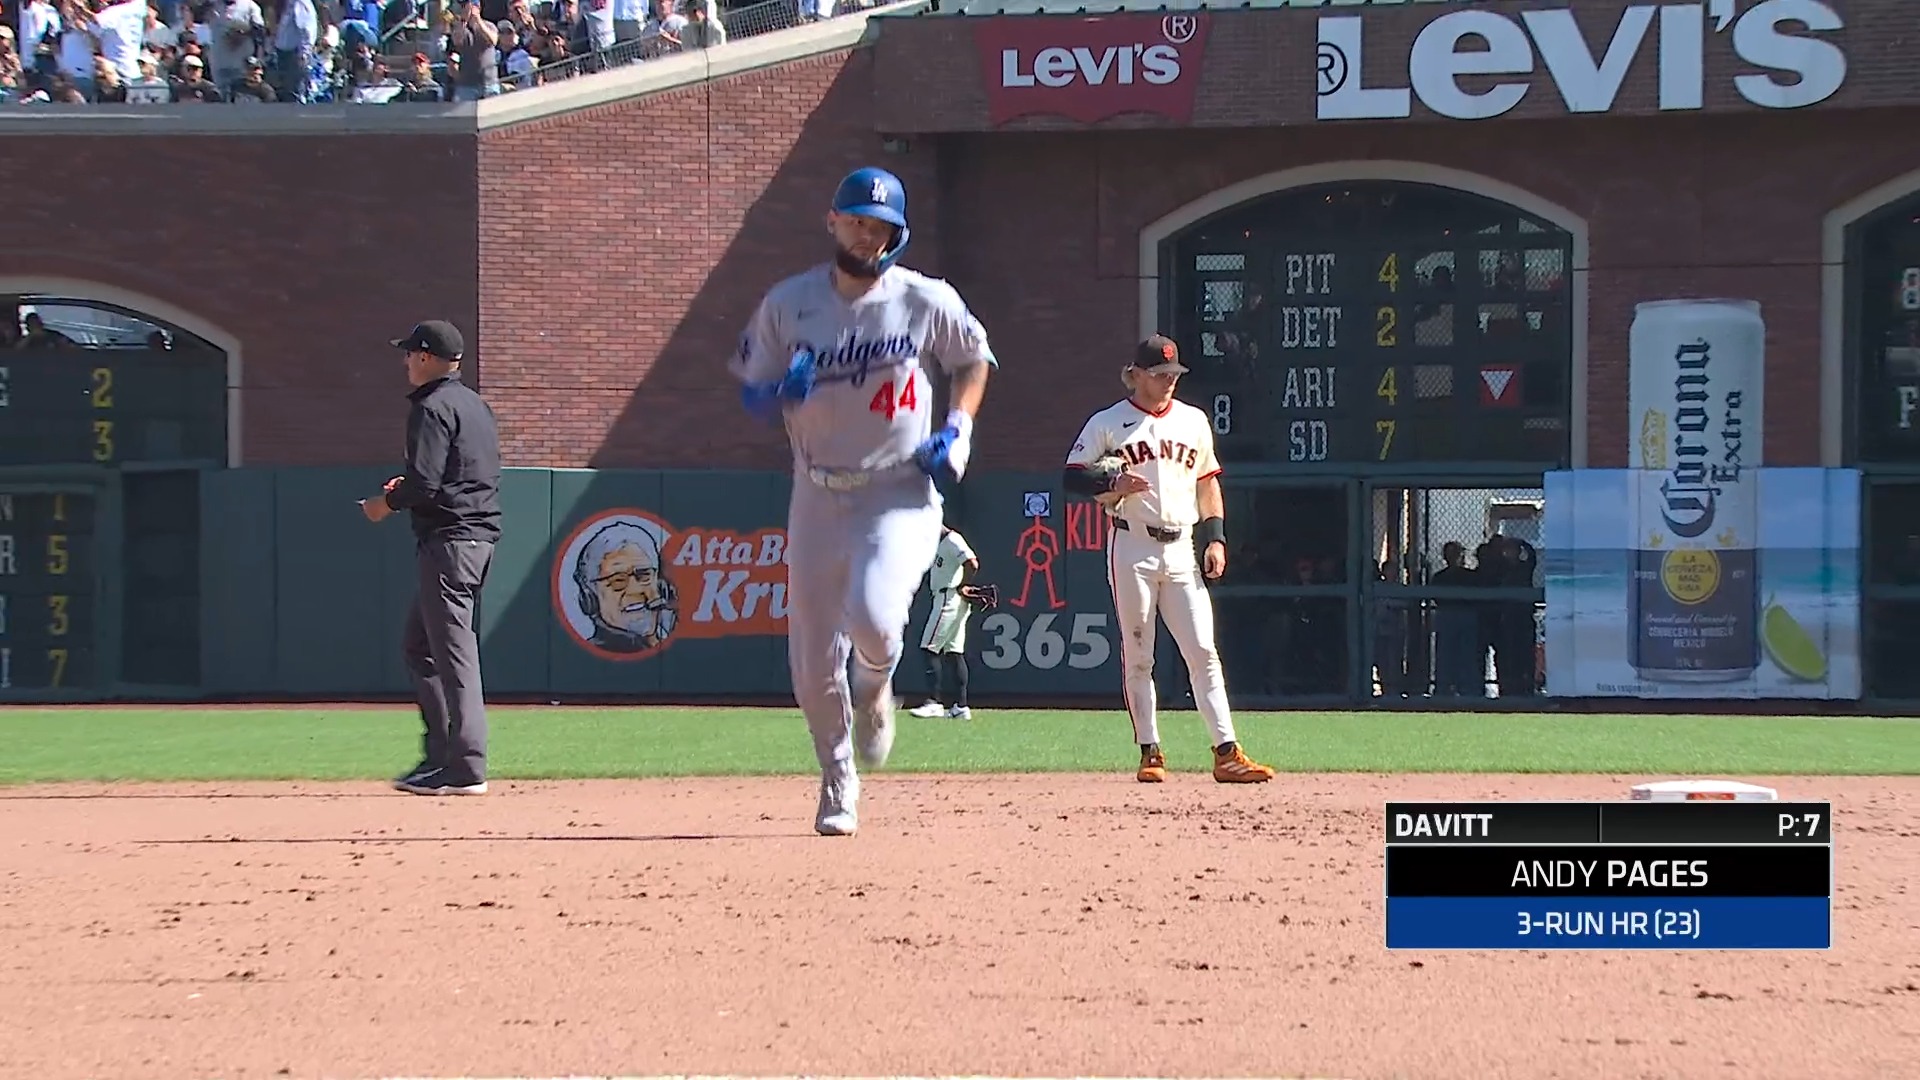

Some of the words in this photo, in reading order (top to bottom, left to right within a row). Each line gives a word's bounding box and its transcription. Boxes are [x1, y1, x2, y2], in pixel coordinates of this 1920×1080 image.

[1285, 253, 1336, 295] PIT
[1377, 253, 1398, 292] 4
[1281, 306, 1341, 348] DET
[1376, 306, 1397, 346] 2
[790, 327, 920, 388] odgers
[92, 368, 113, 408] 2
[869, 368, 917, 422] 44
[1281, 366, 1337, 408] ARI
[1377, 367, 1398, 406] 4
[1213, 394, 1233, 435] 8
[92, 421, 114, 461] 3
[1288, 420, 1329, 462] SD
[1376, 420, 1397, 462] 7
[1660, 343, 1721, 538] Corona
[1711, 390, 1743, 484] Extra
[1066, 502, 1112, 550] KU
[47, 535, 68, 574] 5
[673, 534, 753, 567] Atta
[755, 534, 788, 567] B
[48, 596, 68, 635] 3
[981, 613, 1110, 669] 365
[48, 649, 68, 688] 7
